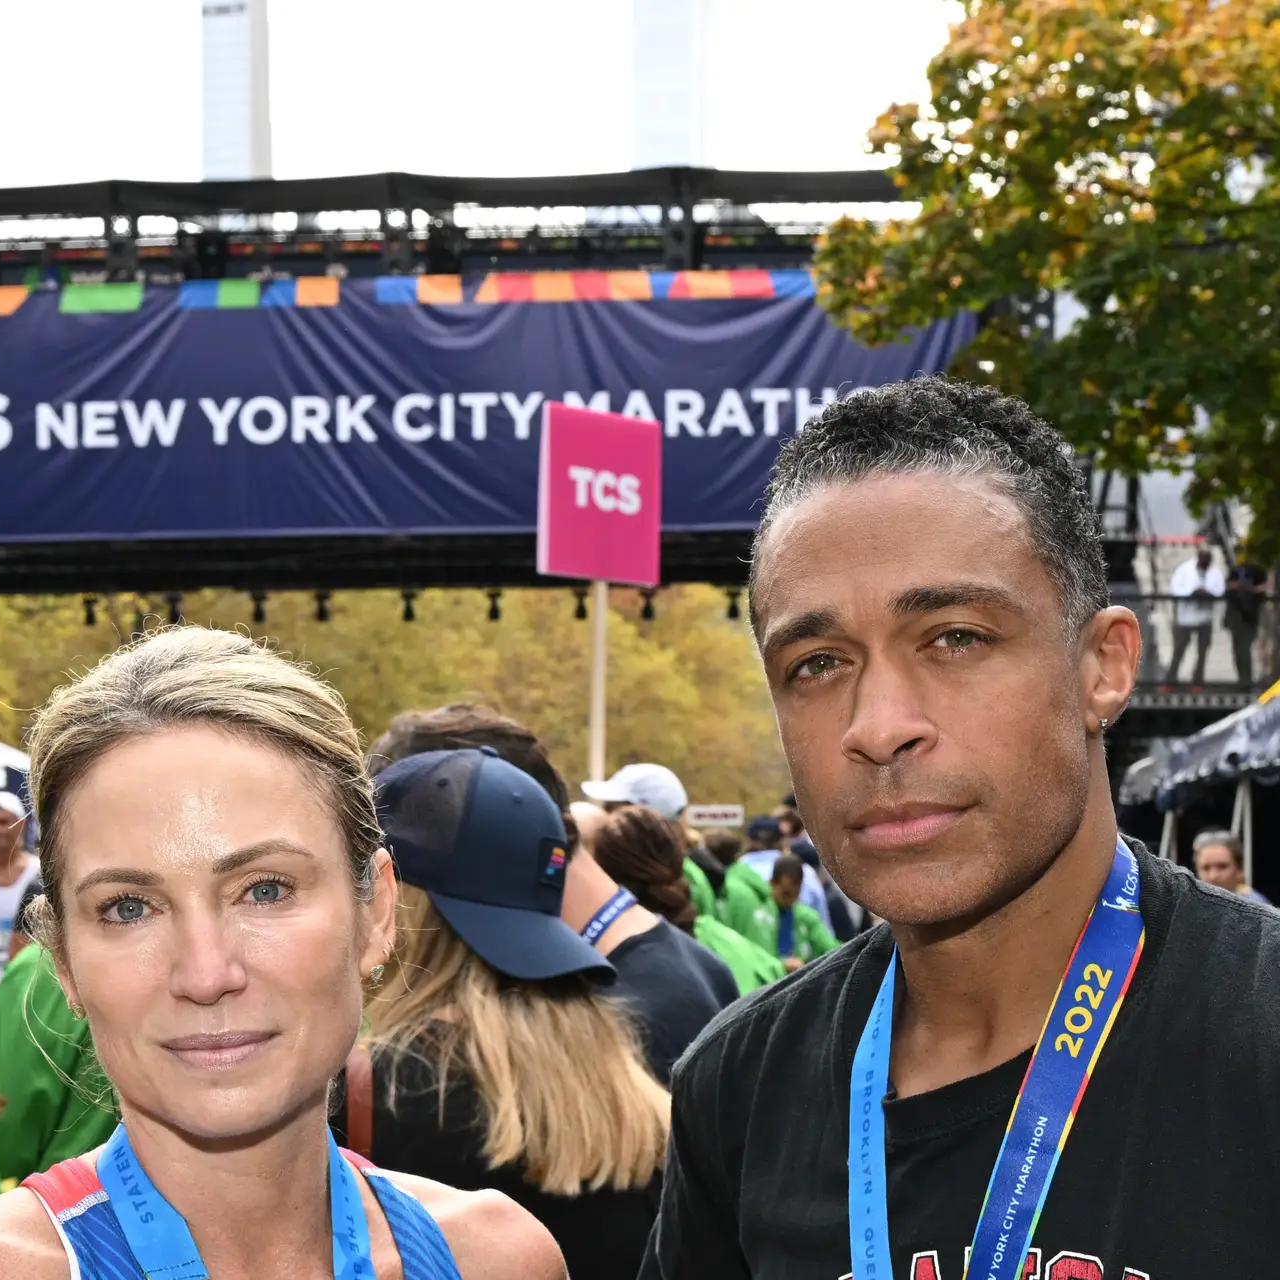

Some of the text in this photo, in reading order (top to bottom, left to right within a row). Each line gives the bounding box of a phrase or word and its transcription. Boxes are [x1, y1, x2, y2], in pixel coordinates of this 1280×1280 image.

[35, 399, 186, 450] NEW
[198, 394, 378, 445] YORK
[392, 391, 544, 442] CITY
[562, 386, 877, 438] ARATH
[568, 464, 641, 516] TCS
[1122, 876, 1138, 896] tcs
[1055, 963, 1113, 1059] 2022
[861, 1069, 874, 1195] BROOKLYN
[112, 1145, 154, 1224] STATEN
[991, 1232, 1010, 1272] YORK
[1003, 1197, 1020, 1231] CITY
[1014, 1116, 1049, 1195] MARATHON
[346, 1215, 360, 1254] THE
